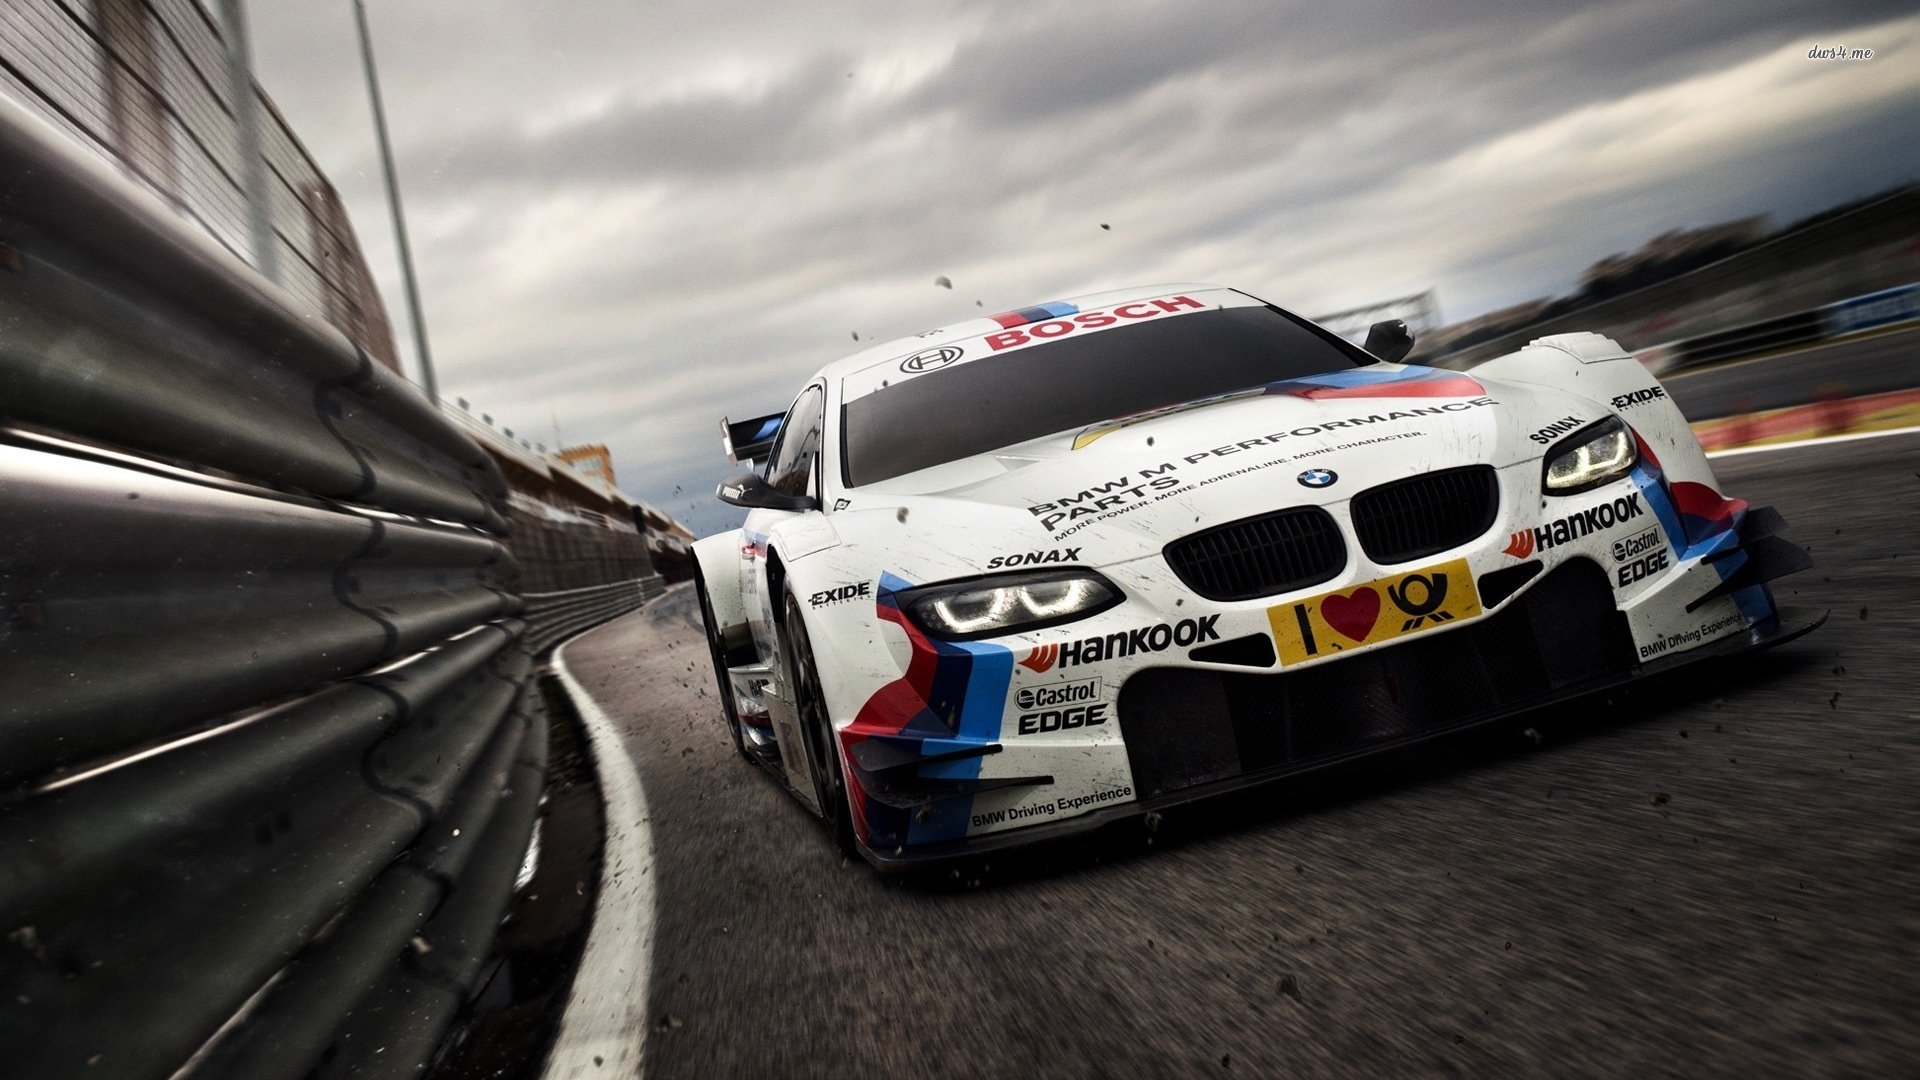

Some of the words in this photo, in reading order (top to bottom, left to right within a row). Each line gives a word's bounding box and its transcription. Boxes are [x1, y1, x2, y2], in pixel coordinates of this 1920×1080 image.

[984, 295, 1206, 352] BOSCH
[1610, 386, 1665, 408] EXIDE
[1529, 415, 1586, 445] SONAX
[1027, 476, 1129, 516] BMW
[1138, 462, 1178, 479] M
[1183, 396, 1500, 465] PERFORMANCE
[1040, 476, 1180, 532] PARTS
[1054, 517, 1096, 542] MORE
[1096, 500, 1154, 522] POWER.
[1154, 483, 1197, 502] MORE
[1199, 458, 1292, 488] ADRENALINE.
[1292, 446, 1336, 461] MORE
[1336, 430, 1427, 451] CHARACTER.
[987, 547, 1083, 570] SONAX
[1625, 528, 1661, 557] Castrol
[1618, 547, 1670, 588] EDGE
[808, 581, 870, 607] EXIDE
[1293, 603, 1319, 656] I
[1640, 639, 1667, 658] BMW
[1668, 629, 1701, 650] Driving
[1701, 612, 1742, 637] Experience
[1036, 681, 1097, 707] Castrol
[1018, 703, 1110, 736] EDGE
[972, 810, 1006, 828] BMW
[1008, 801, 1055, 820] Driving
[1057, 786, 1132, 811] Experience
